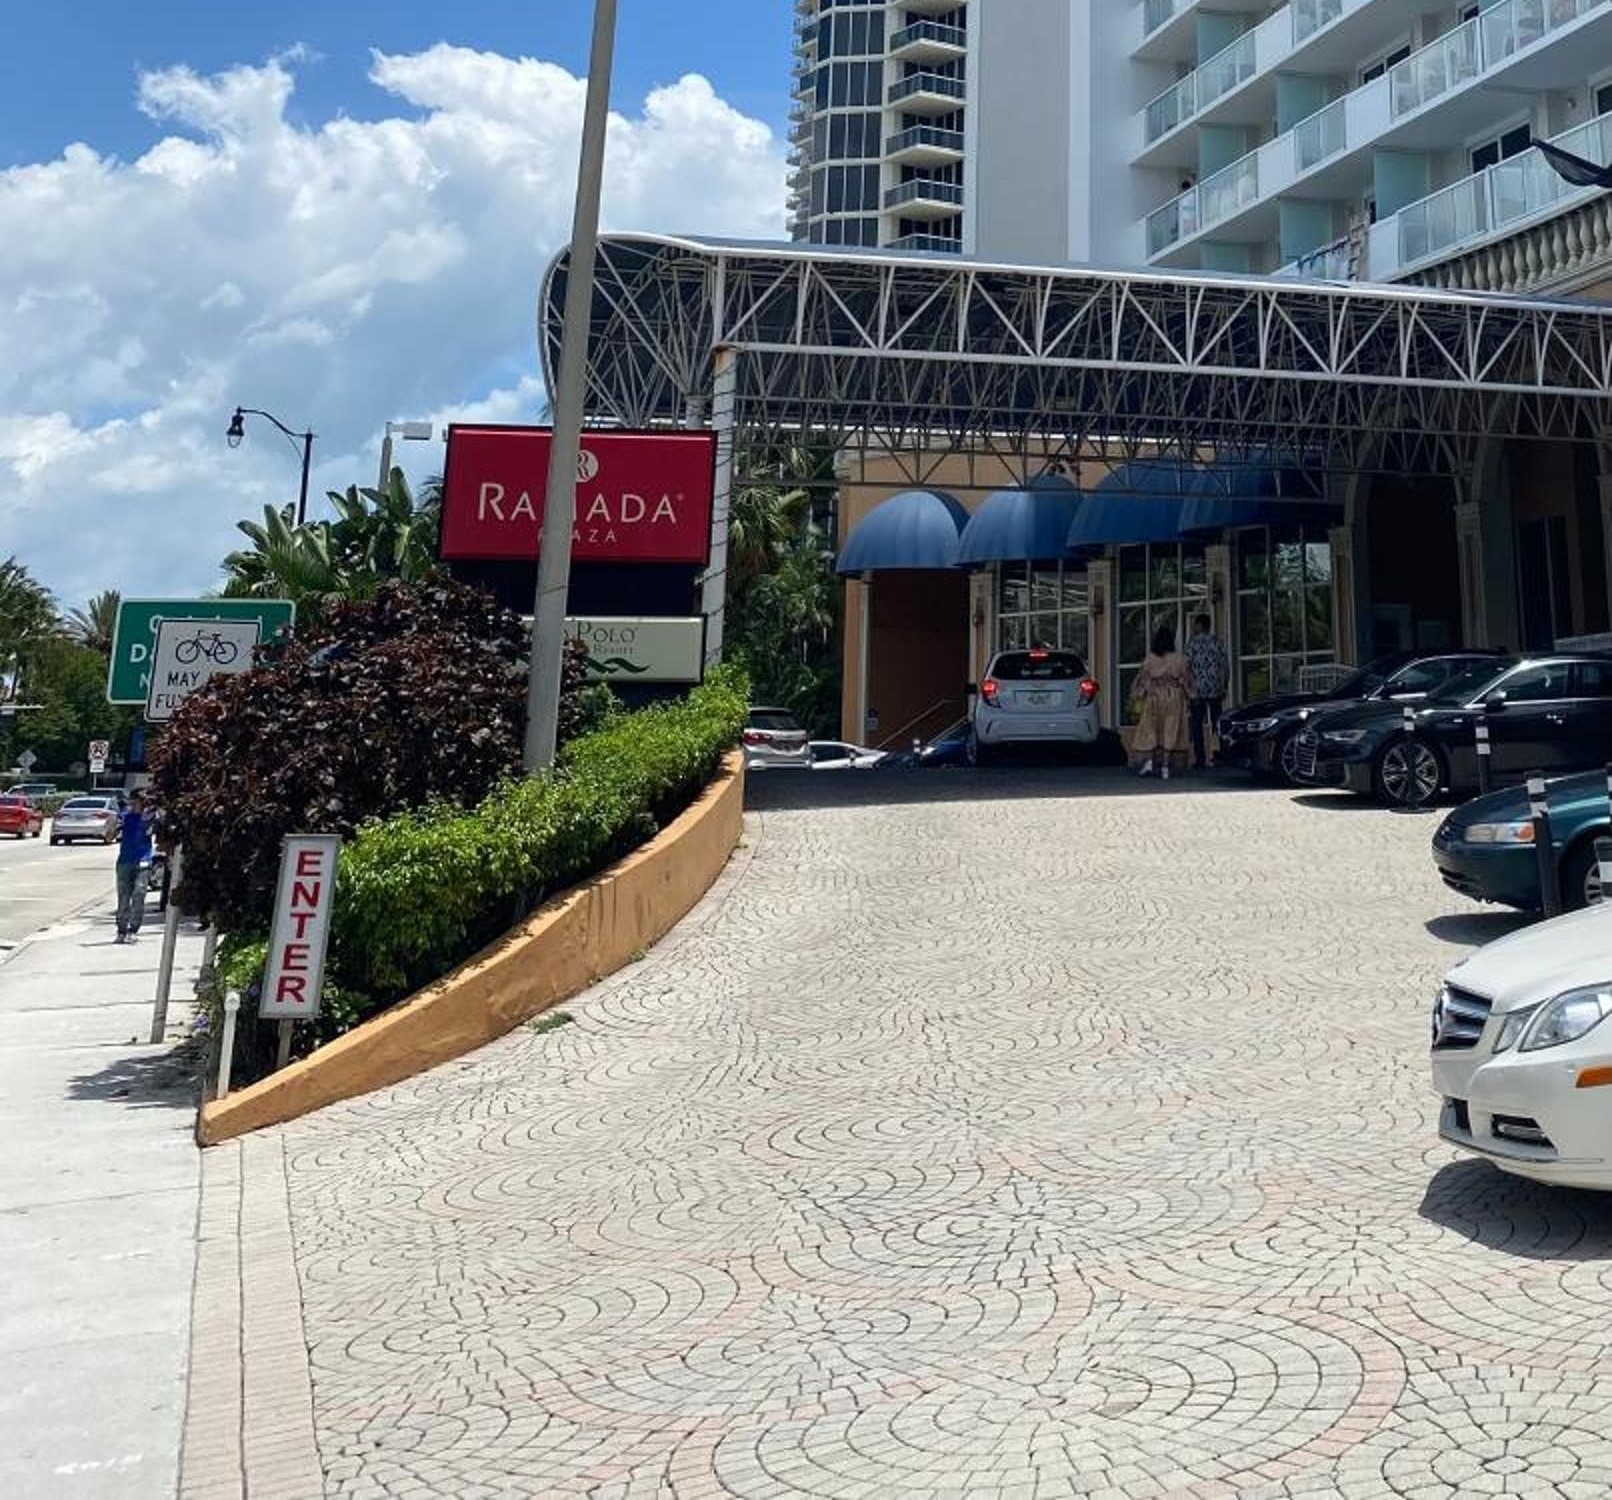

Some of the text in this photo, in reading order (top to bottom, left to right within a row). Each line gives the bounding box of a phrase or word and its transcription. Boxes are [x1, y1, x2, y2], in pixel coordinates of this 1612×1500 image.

[478, 482, 677, 524] RAADA
[167, 671, 200, 687] MAY
[275, 851, 324, 1002] ENTER
